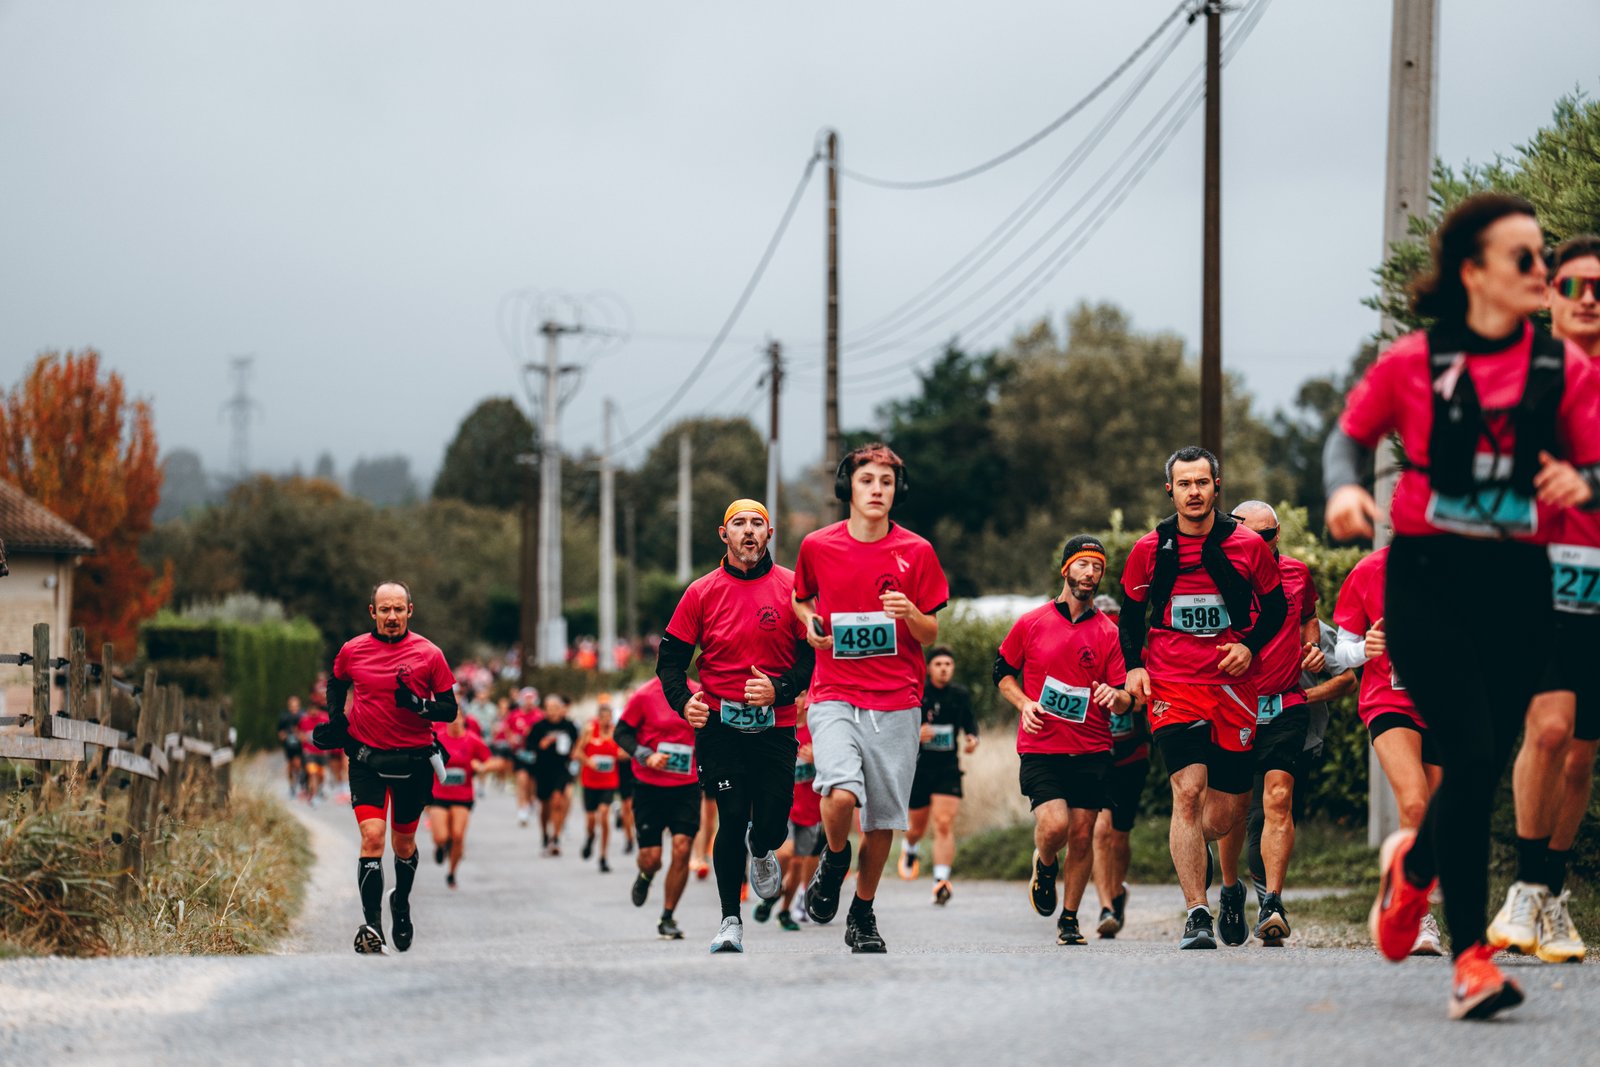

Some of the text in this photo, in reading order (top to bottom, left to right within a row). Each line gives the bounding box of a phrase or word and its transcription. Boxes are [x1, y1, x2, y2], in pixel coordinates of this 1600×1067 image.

[1181, 607, 1221, 628] 598
[841, 626, 888, 649] 480
[1045, 690, 1082, 715] 302
[728, 706, 768, 726] 256
